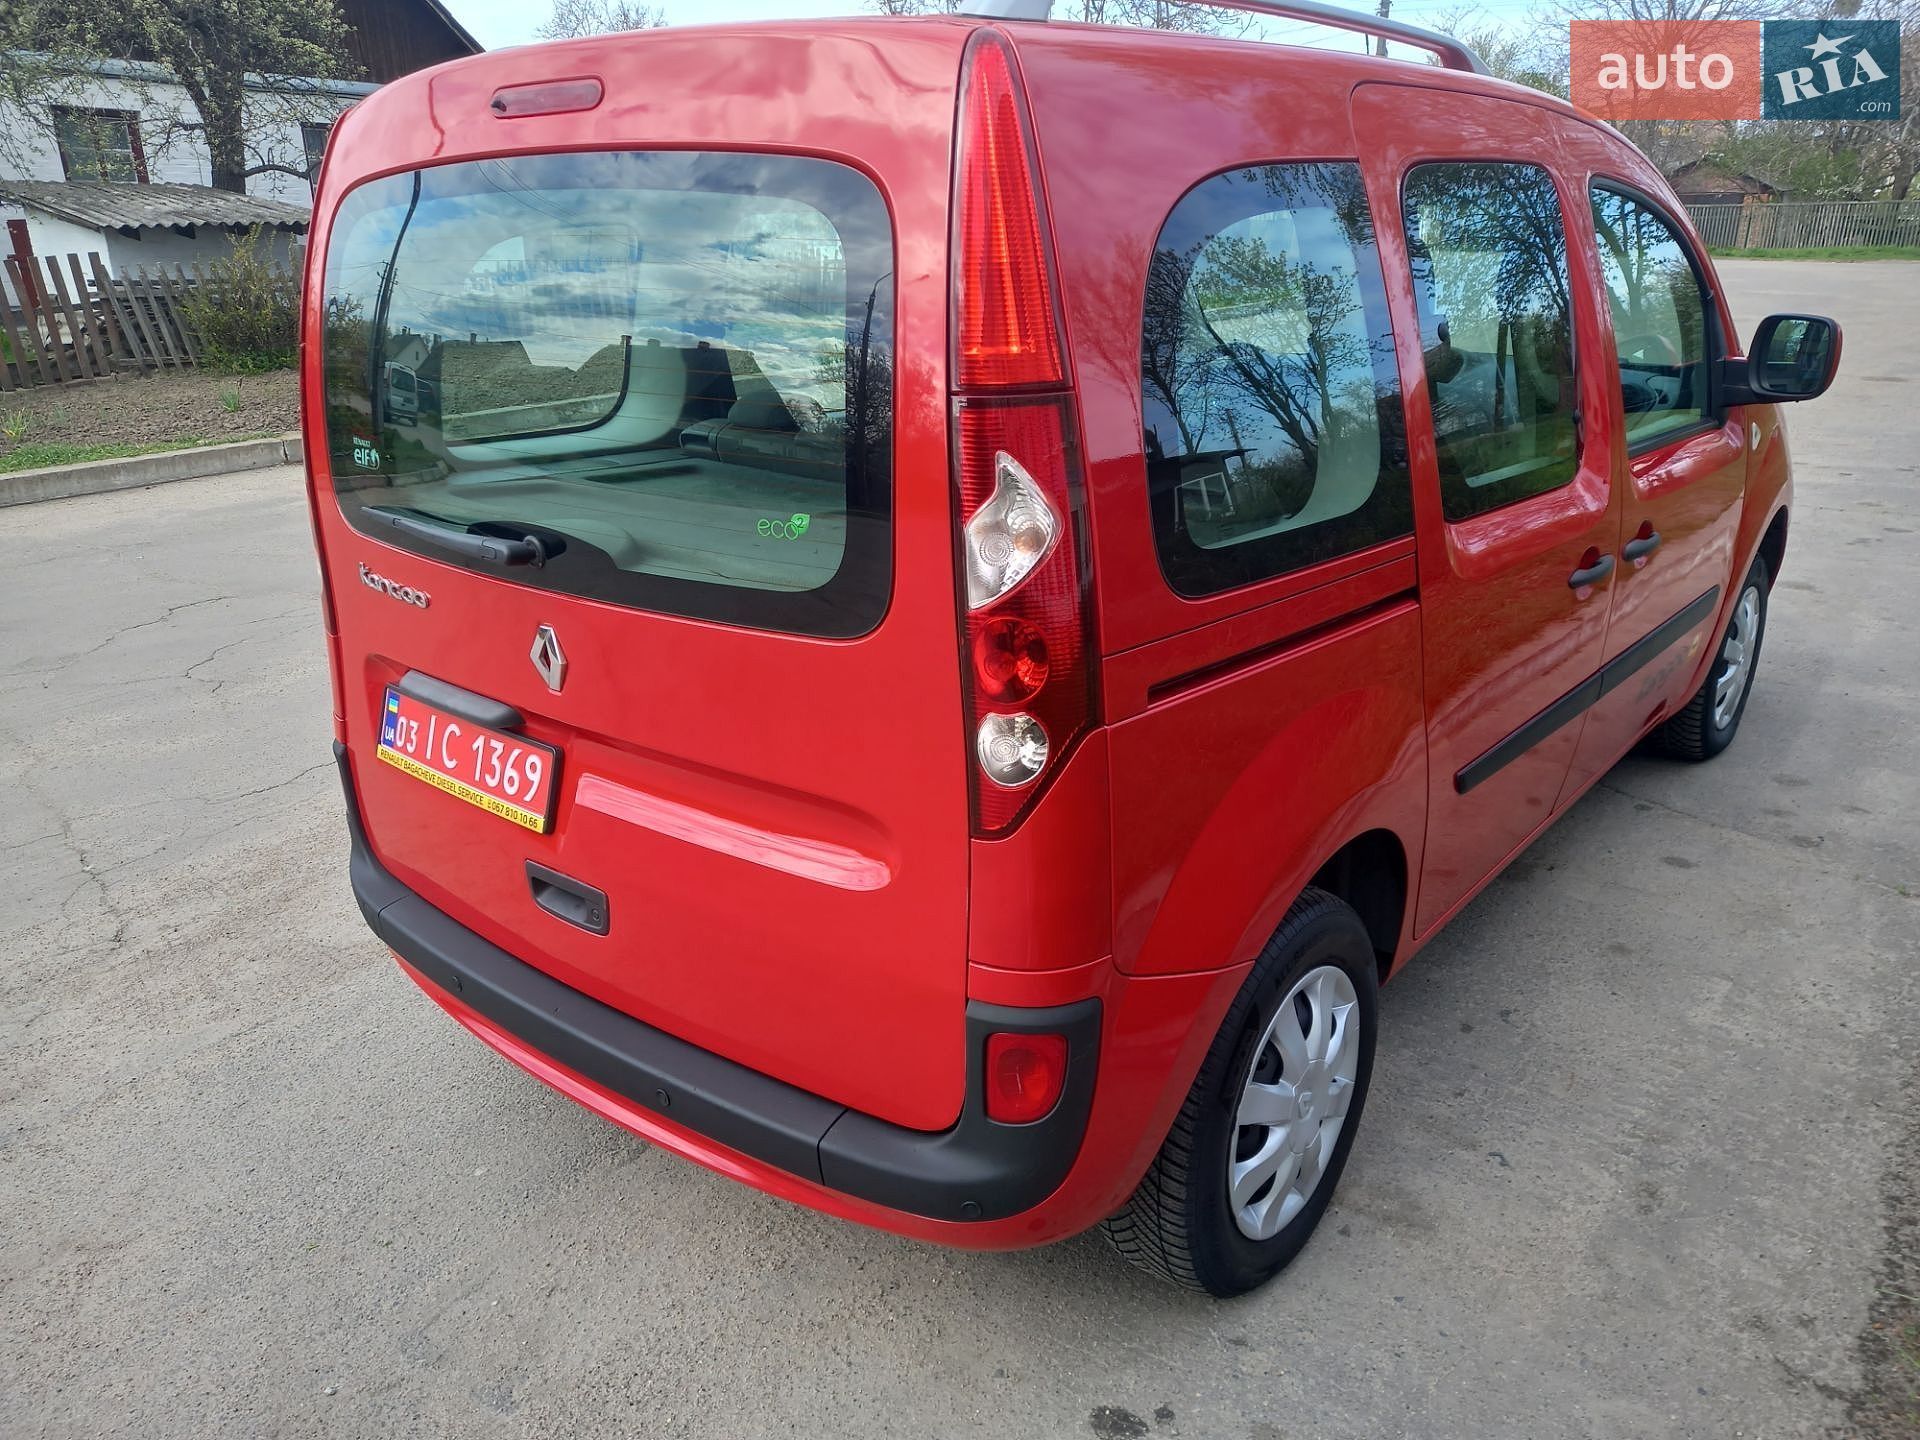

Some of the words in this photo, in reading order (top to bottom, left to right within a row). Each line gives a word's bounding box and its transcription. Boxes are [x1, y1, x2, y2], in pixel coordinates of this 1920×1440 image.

[384, 725, 395, 742] UA
[396, 716, 418, 753] 03
[472, 735, 542, 802] 1369
[380, 748, 404, 767] RENAULT
[436, 776, 457, 794] DIESEL
[457, 785, 485, 806] SERVICE
